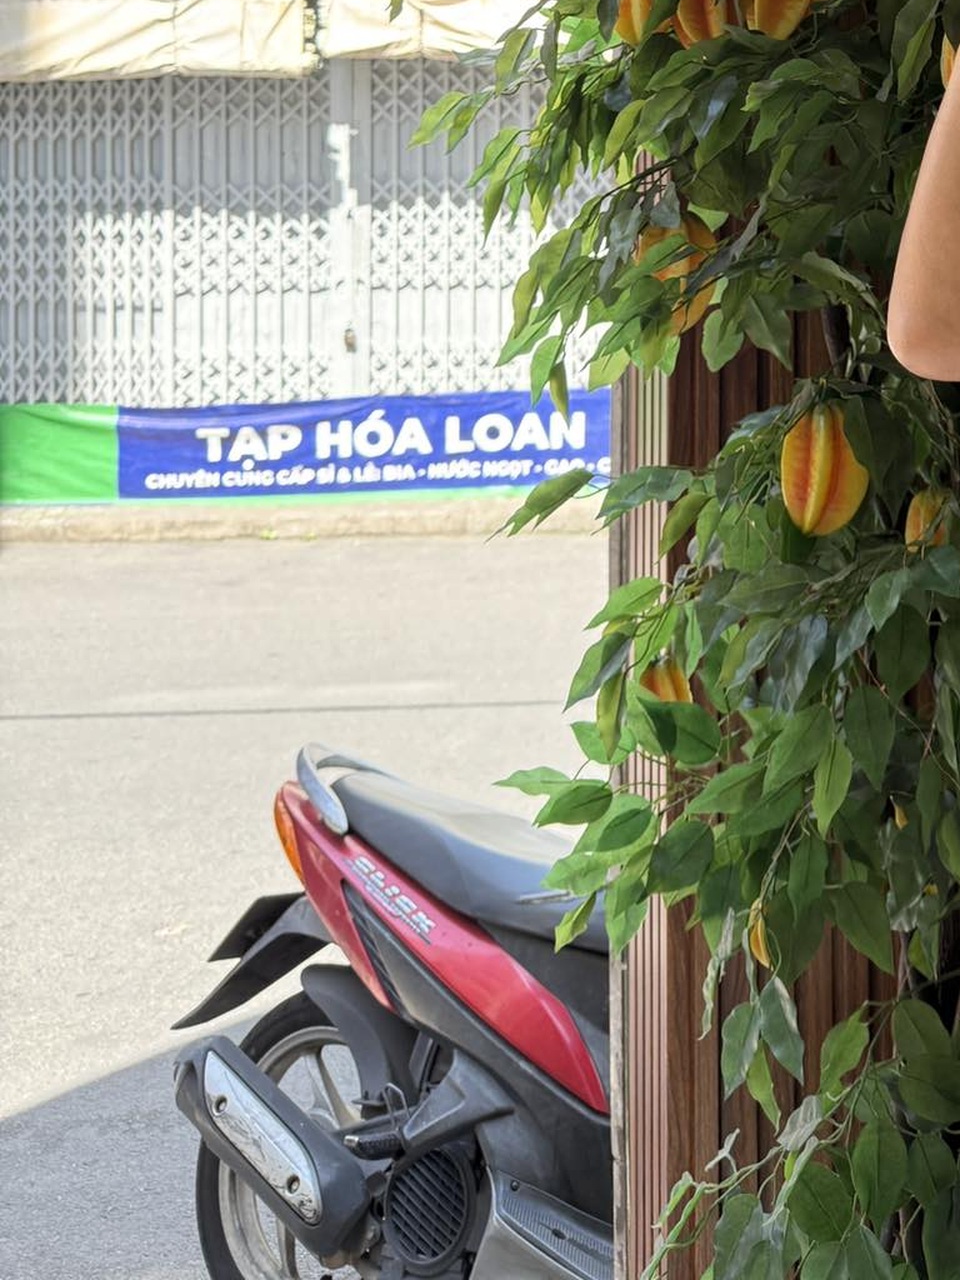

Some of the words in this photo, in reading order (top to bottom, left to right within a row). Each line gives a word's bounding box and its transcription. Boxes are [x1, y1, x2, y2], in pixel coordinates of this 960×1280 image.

[195, 424, 302, 470] TẠP
[315, 409, 433, 460] HÓA
[445, 411, 586, 454] LOAN
[145, 469, 221, 489] CHUYÊN
[276, 464, 315, 486] CẤP
